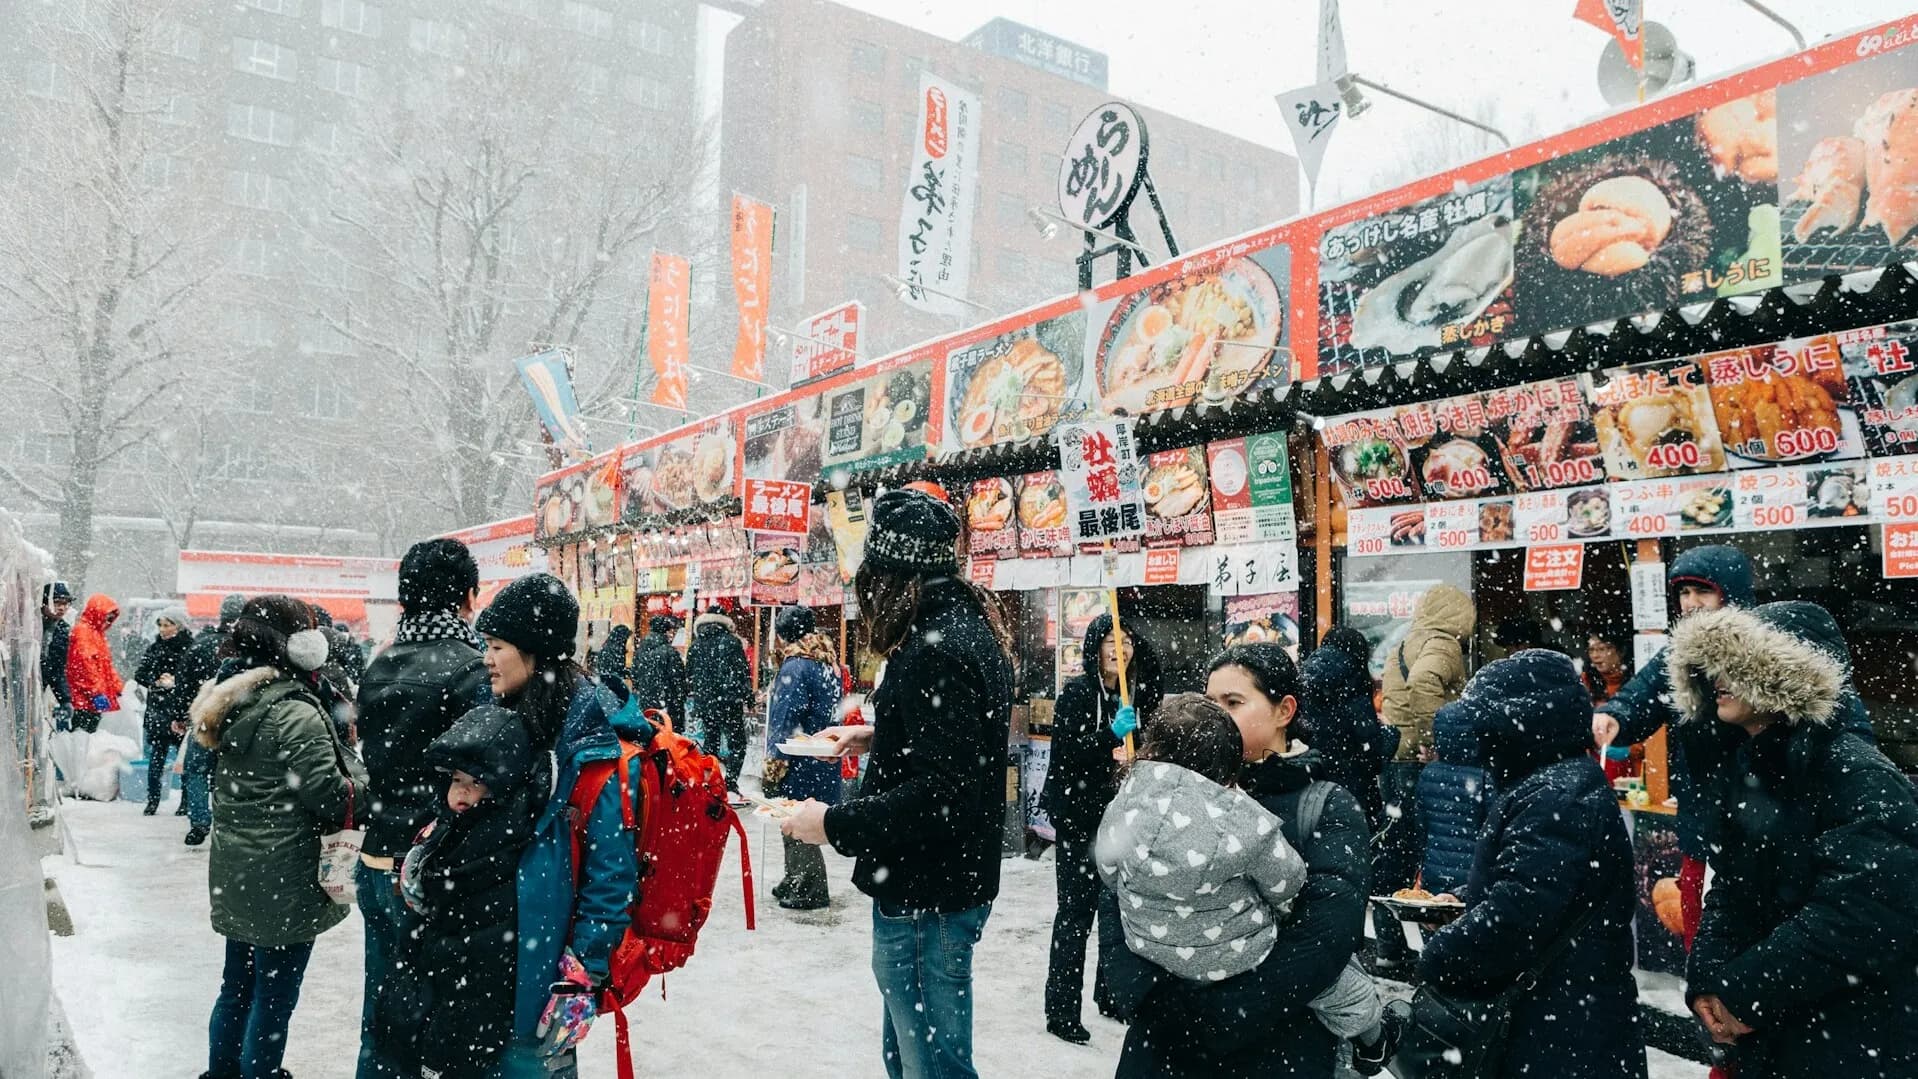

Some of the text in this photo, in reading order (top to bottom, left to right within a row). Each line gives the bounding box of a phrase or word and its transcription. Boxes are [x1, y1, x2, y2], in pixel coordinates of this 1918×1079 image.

[1018, 32, 1090, 73] 北洋銀行
[1328, 208, 1439, 259] あっけし名産
[1681, 258, 1770, 293] 蒸しうに
[1441, 316, 1505, 344] 蒸しかき
[1710, 346, 1834, 385] 蒸しうに
[1868, 341, 1915, 374] 牡
[1488, 381, 1582, 418] 焼かに足
[1116, 424, 1131, 460] 厚岸町
[1152, 450, 1186, 467] ラーメン
[752, 480, 805, 499] ラーメン
[973, 478, 1000, 492] ラーメン
[1027, 471, 1055, 485] ラーメン
[751, 494, 803, 518] 最後尾
[1754, 506, 1794, 526] 500
[1079, 503, 1140, 537] 最後尾
[1629, 515, 1666, 533] 400
[1439, 531, 1467, 548] 500
[1530, 523, 1559, 542] 500
[1358, 538, 1383, 553] 300
[1531, 549, 1579, 568] ご注文
[1215, 554, 1291, 590] 弟子屈
